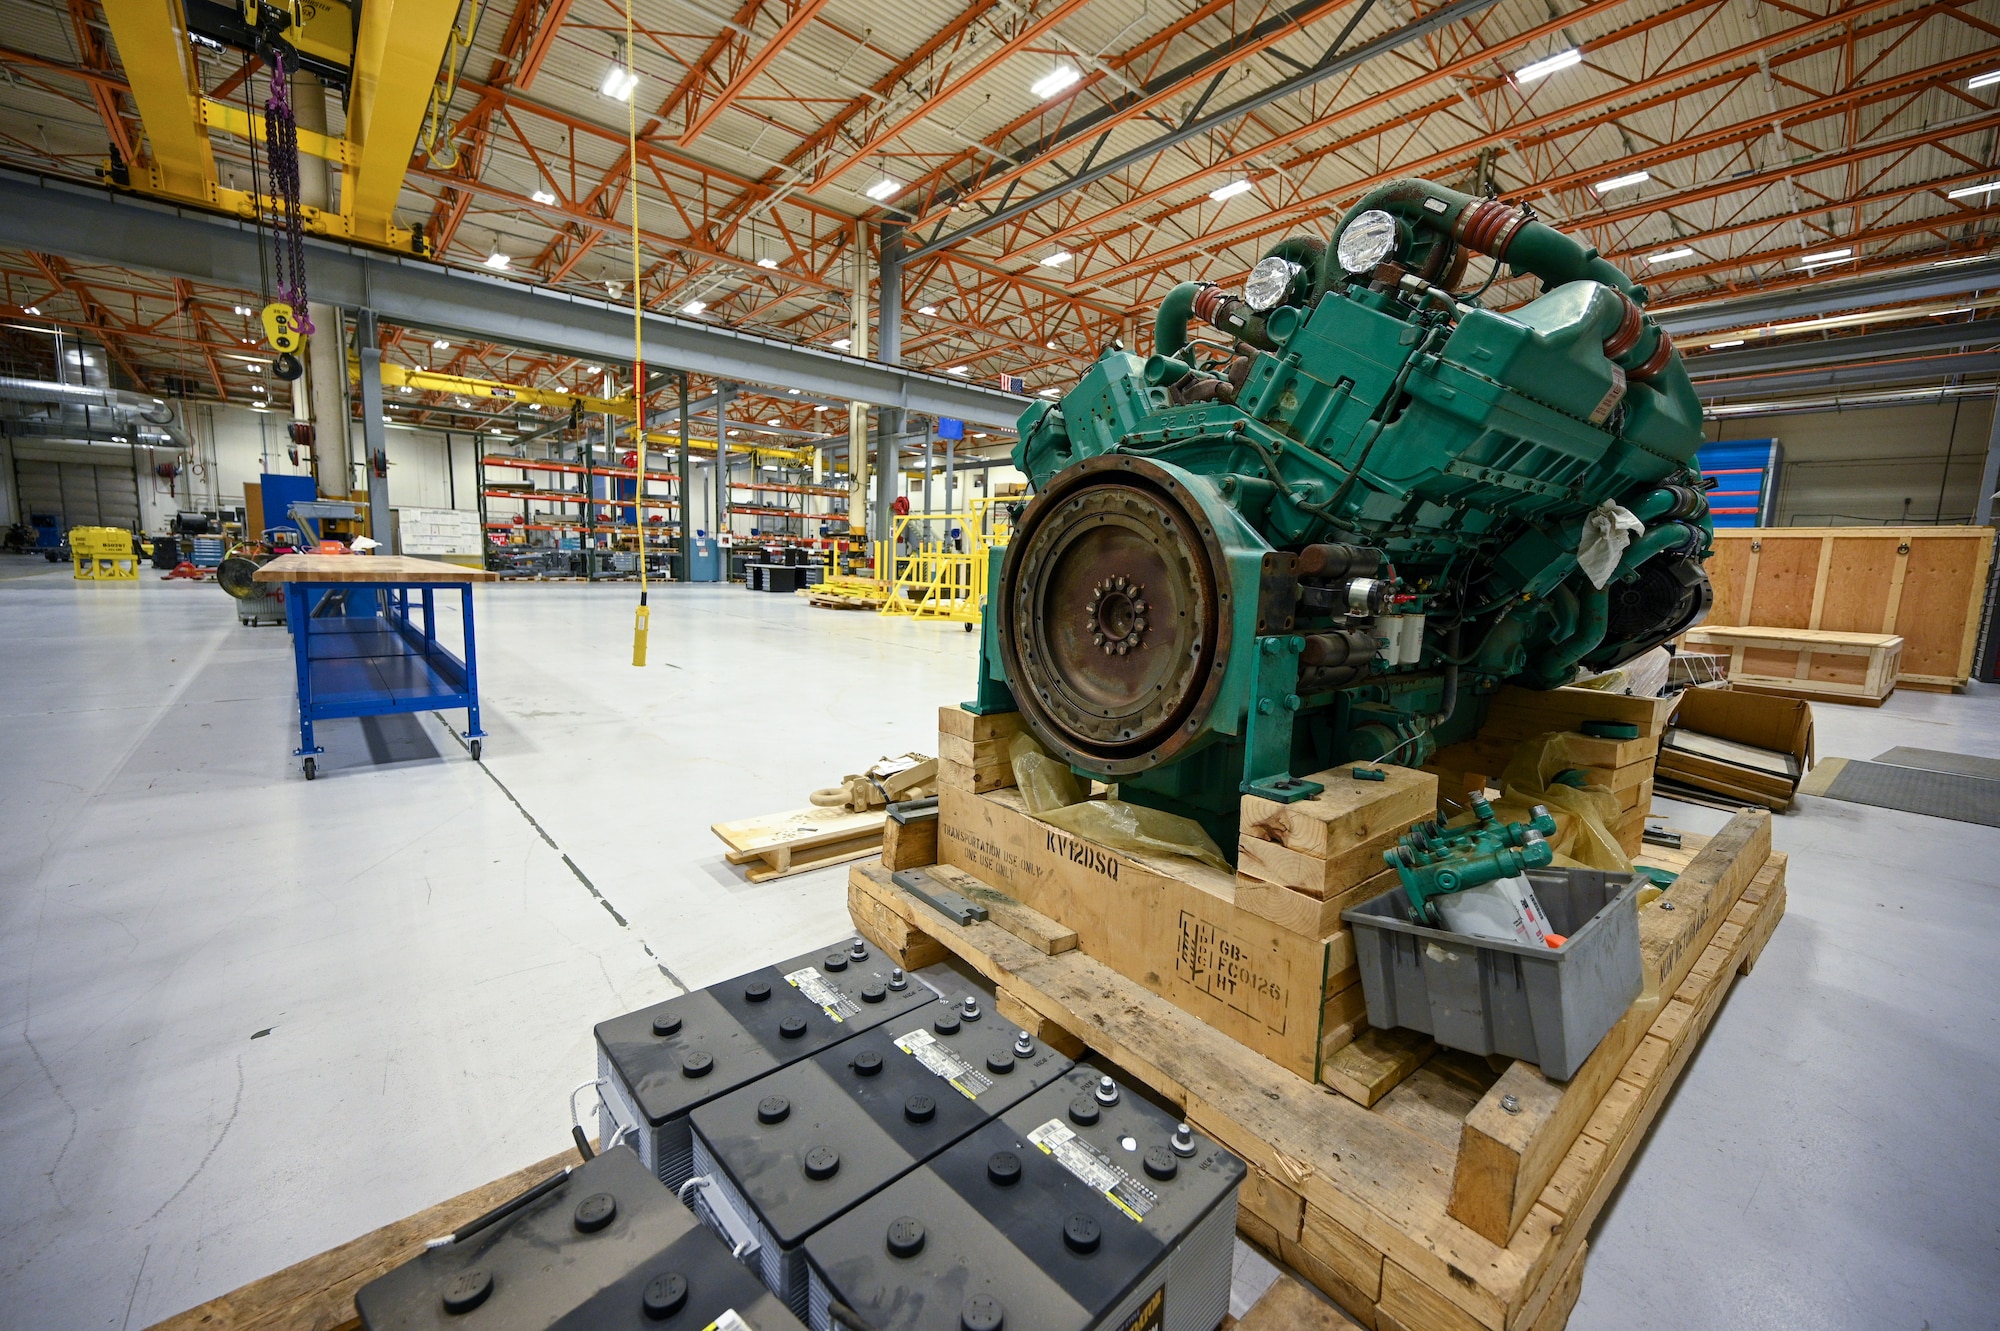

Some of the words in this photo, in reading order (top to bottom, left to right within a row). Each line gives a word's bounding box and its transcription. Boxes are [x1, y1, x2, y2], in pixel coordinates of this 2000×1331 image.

[943, 823, 1001, 860] TRANSPORTATION
[1003, 852, 1018, 868] USE
[1020, 860, 1043, 878] ONLY
[964, 847, 978, 863] ONE
[979, 857, 993, 871] USE
[995, 864, 1014, 881] ONLY
[1216, 973, 1237, 995] HT
